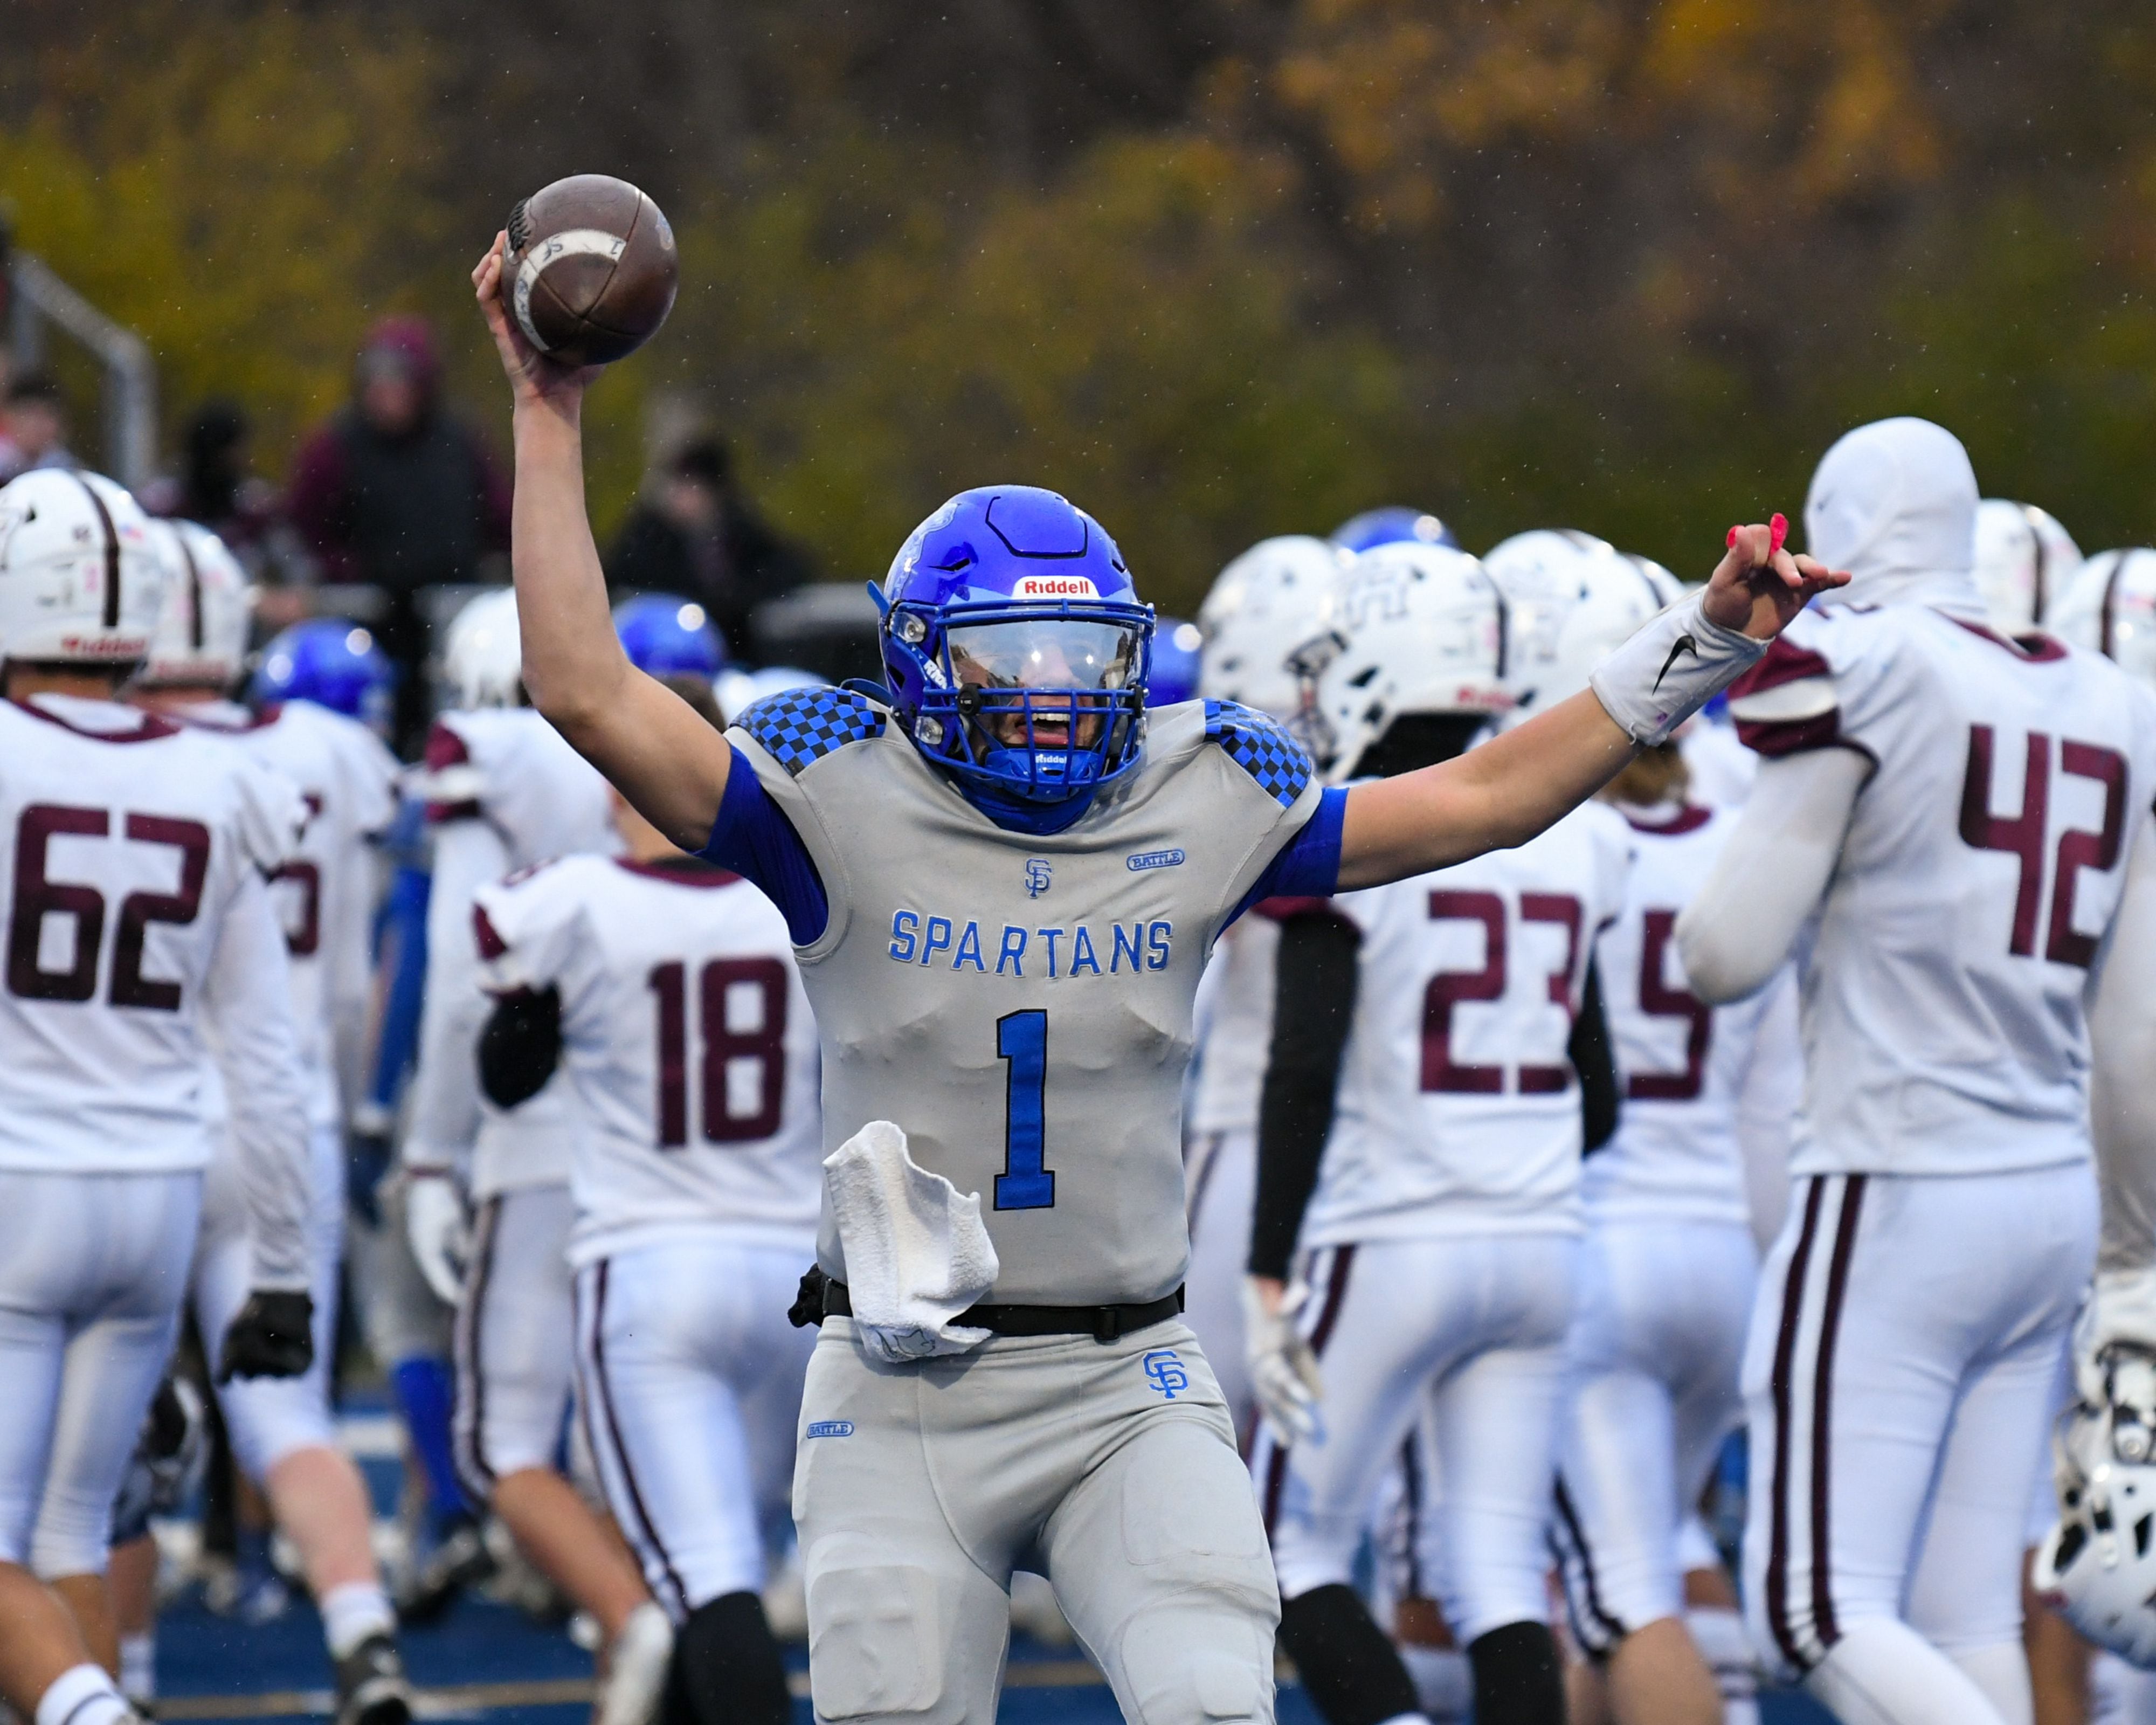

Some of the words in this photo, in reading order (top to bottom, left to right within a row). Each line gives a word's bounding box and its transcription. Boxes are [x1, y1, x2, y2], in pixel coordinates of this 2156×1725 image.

[1025, 581, 1089, 594] Riddell
[1035, 754, 1067, 764] Riddel
[1959, 724, 2130, 968] 42
[5, 802, 211, 1013] 62
[889, 909, 1173, 979] SPARTANS
[1132, 852, 1180, 868] BATTLE
[648, 957, 789, 1149] 18
[1420, 890, 1583, 1094] 23
[993, 1009, 1055, 1211] 1
